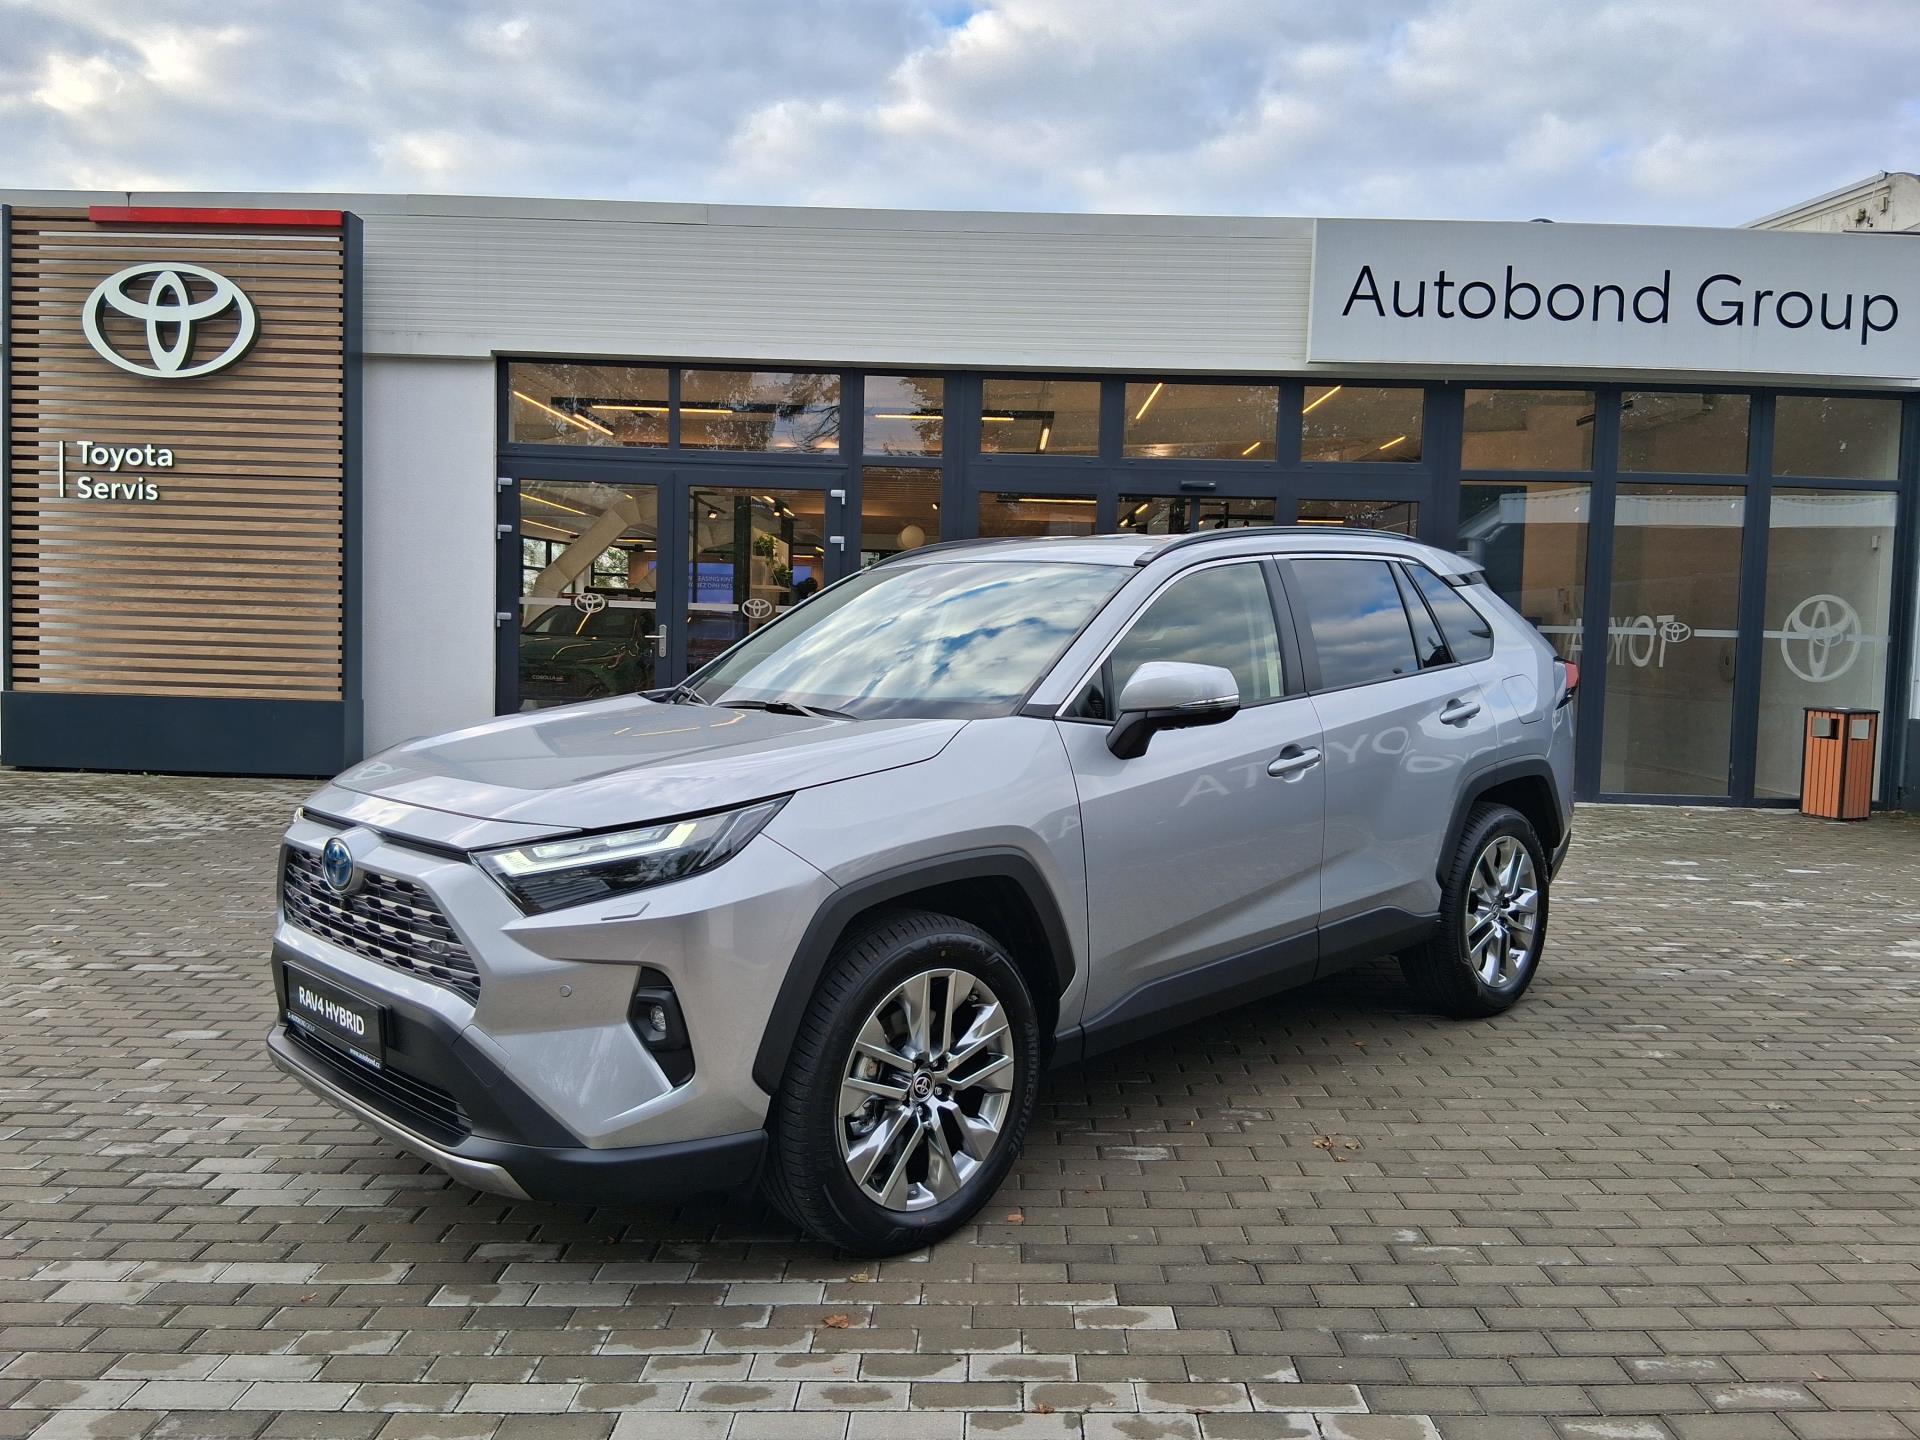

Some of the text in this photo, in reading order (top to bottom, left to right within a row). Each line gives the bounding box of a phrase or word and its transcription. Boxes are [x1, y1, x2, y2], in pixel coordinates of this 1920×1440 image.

[1342, 264, 1900, 346] Autobond Group
[76, 440, 174, 472] Toyota
[76, 476, 160, 501] Servis
[298, 986, 365, 1036] RAV4 HYBRID
